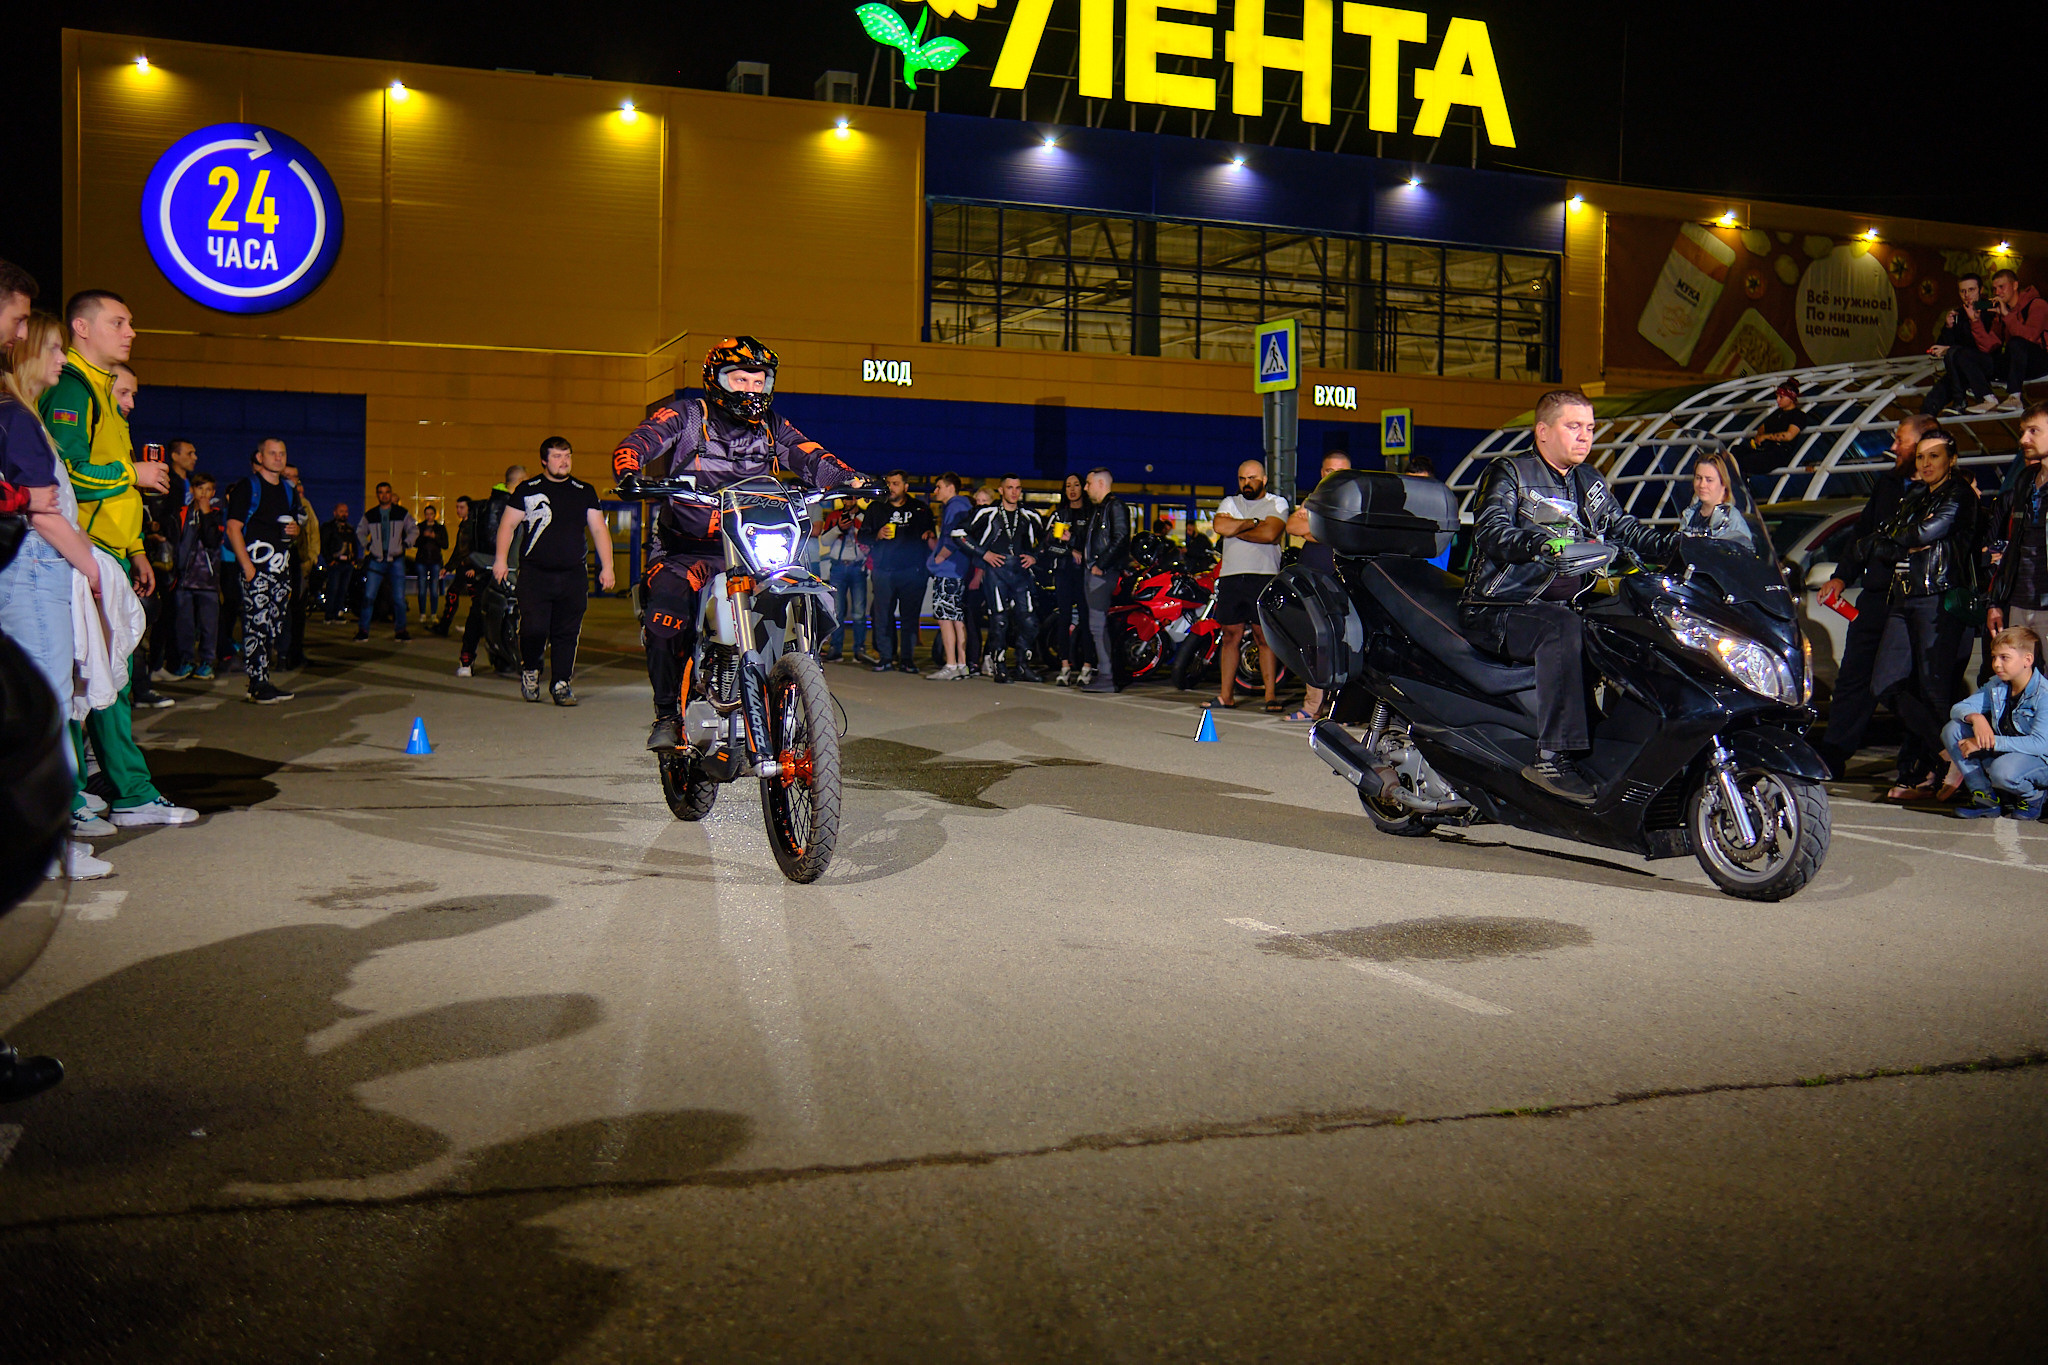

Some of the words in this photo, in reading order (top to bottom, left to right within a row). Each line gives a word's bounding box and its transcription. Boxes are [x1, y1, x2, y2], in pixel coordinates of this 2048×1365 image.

[989, 0, 1516, 148] ЛЕНТА
[208, 165, 280, 234] 24
[207, 236, 279, 271] ЧАСА
[1806, 289, 1830, 305] Всё
[1833, 296, 1892, 311] нужное!
[1806, 305, 1826, 321] По
[1829, 312, 1879, 326] низким
[1805, 324, 1850, 338] ценам
[863, 359, 912, 386] ВХОД
[1314, 385, 1357, 410] ВХОД
[652, 612, 683, 630] FOX
